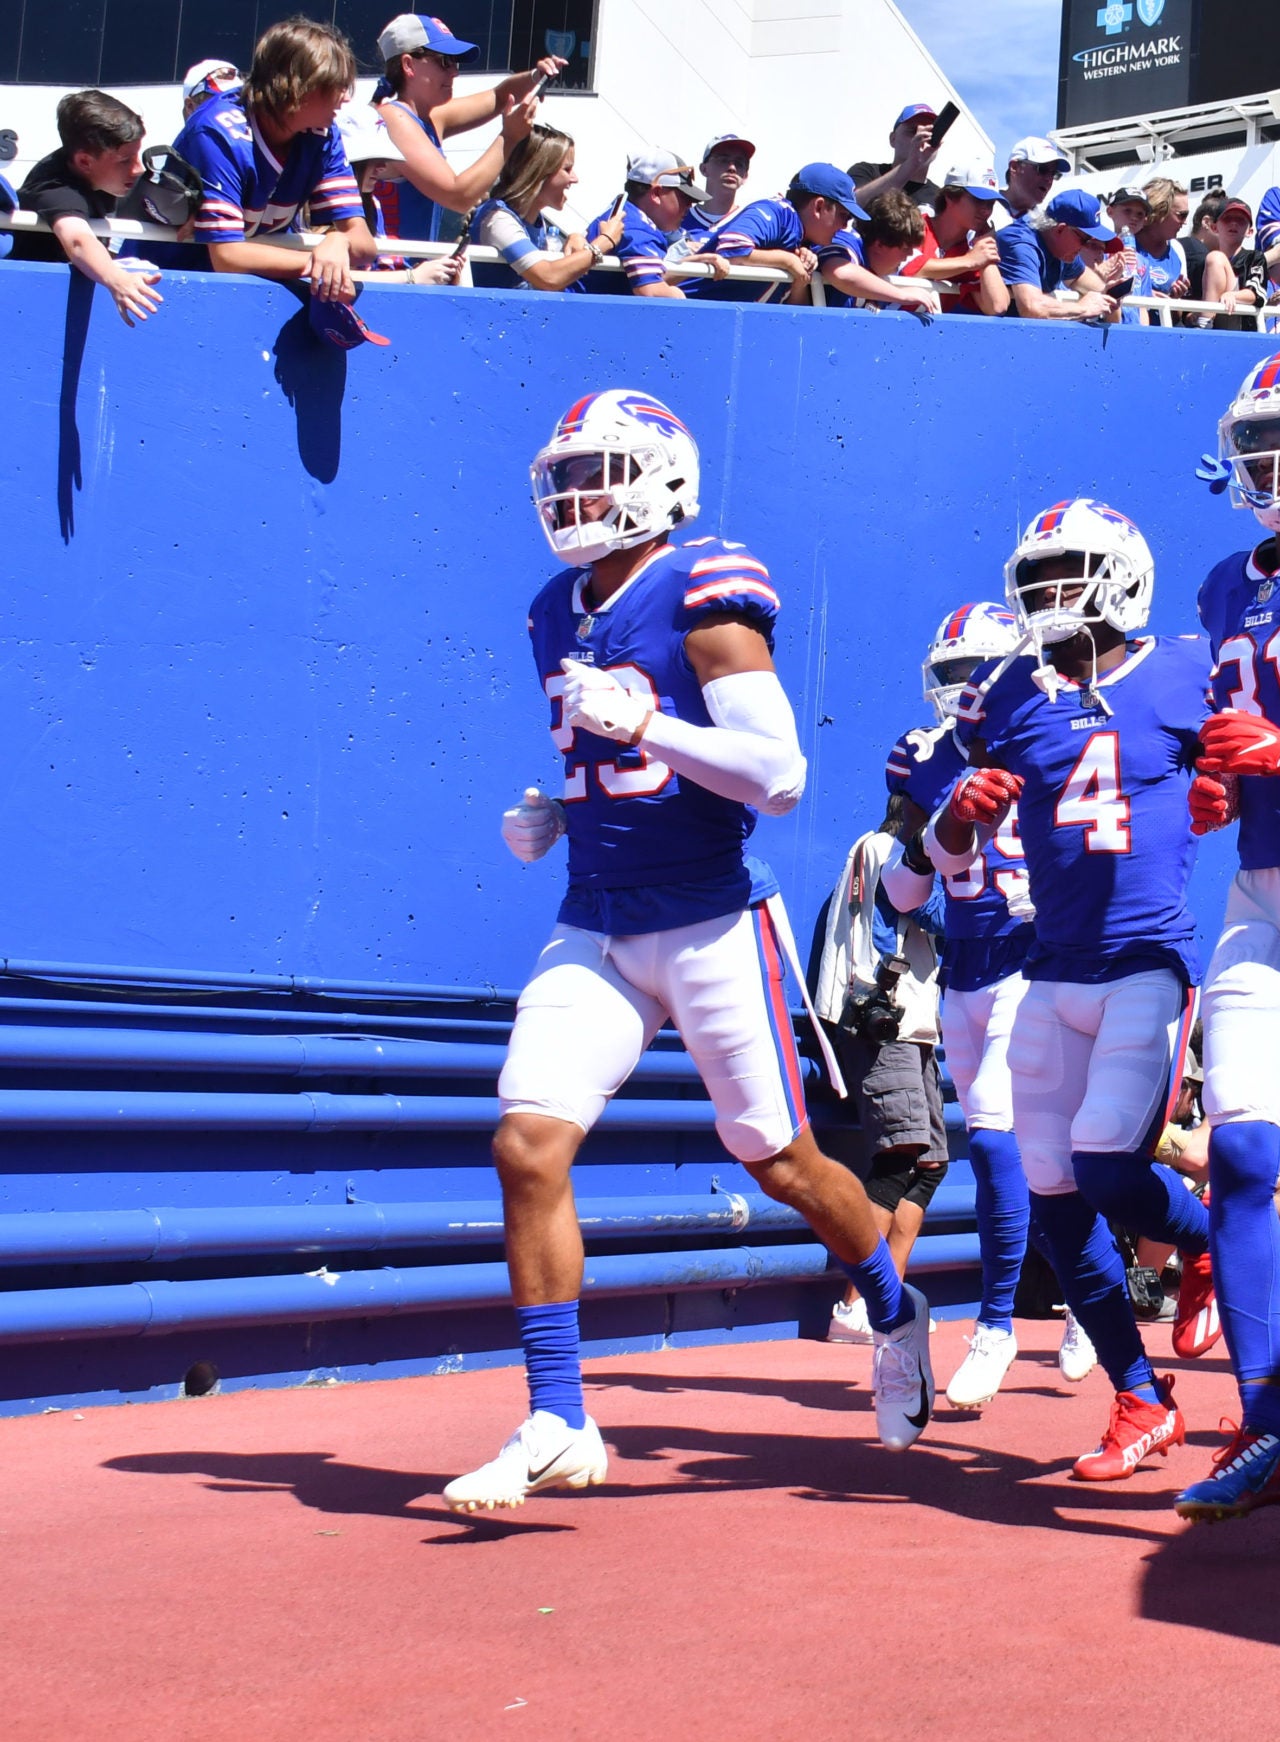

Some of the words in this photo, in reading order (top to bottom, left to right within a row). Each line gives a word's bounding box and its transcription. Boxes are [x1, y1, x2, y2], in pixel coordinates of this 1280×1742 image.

[1083, 35, 1181, 69] HIGHMARK
[1083, 63, 1127, 80] WESTERN
[1129, 58, 1152, 73] NEW
[1154, 54, 1180, 67] YORK
[1244, 611, 1274, 628] BILLS
[1070, 715, 1107, 730] BILLS
[1054, 731, 1132, 855] 4
